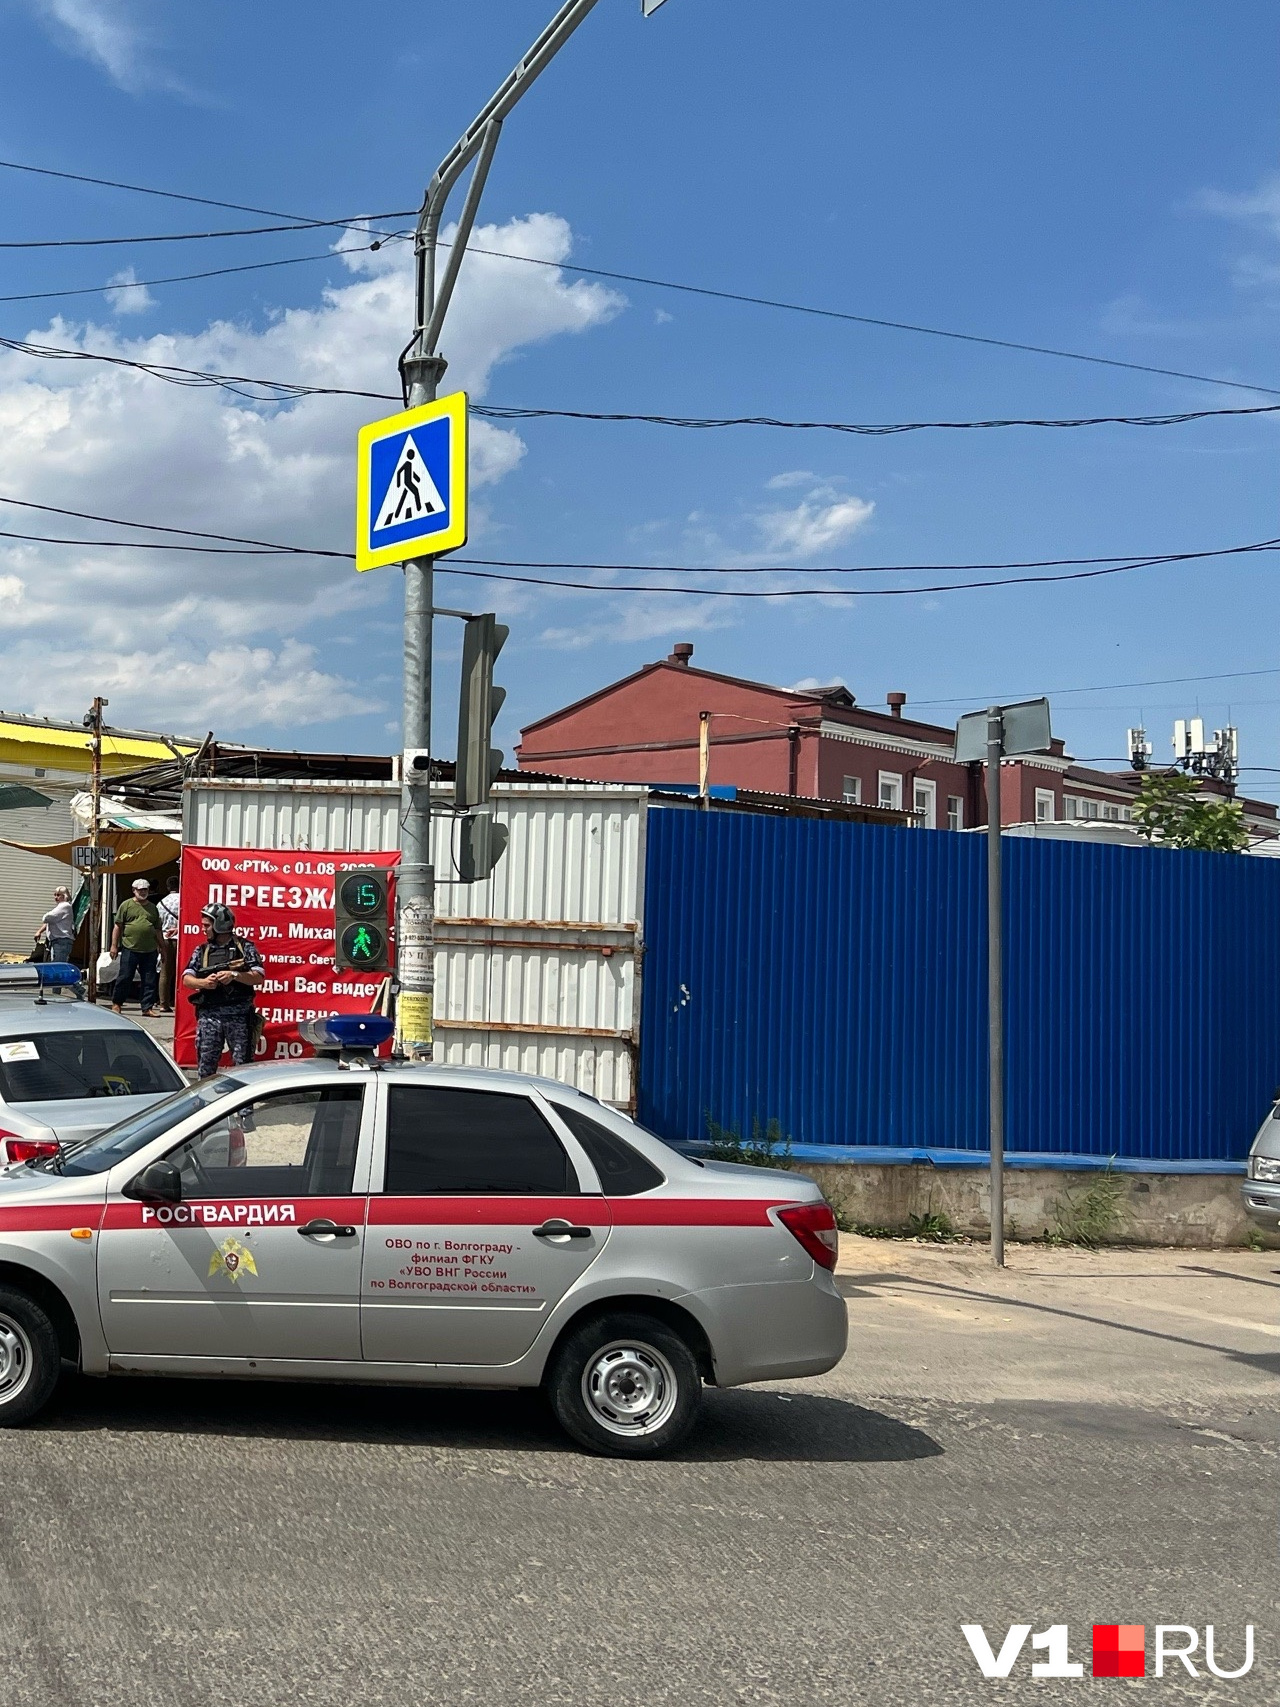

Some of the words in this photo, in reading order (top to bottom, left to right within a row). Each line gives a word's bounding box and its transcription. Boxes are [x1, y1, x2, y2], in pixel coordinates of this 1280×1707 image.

[201, 858, 230, 871] ООО
[234, 860, 278, 873] «РТК»
[282, 864, 291, 874] с
[356, 884, 376, 906] 15
[184, 924, 200, 935] по
[259, 927, 283, 940] ул.
[269, 954, 306, 965] магаз.
[294, 976, 326, 994] Вас
[5, 1044, 30, 1057] Z
[274, 1041, 304, 1059] до
[141, 1204, 296, 1225] РОСГВАРДИЯ
[385, 1239, 412, 1249] ОВО
[416, 1241, 430, 1250] по
[444, 1241, 513, 1254] Волгограду
[411, 1253, 458, 1264] филиал
[462, 1254, 495, 1265] ФГКУ
[400, 1266, 431, 1277] «УВО
[436, 1267, 461, 1277] ВНГ
[464, 1268, 507, 1279] России
[370, 1280, 385, 1289] по
[388, 1279, 477, 1292] Волгоградской
[481, 1282, 536, 1294] области»
